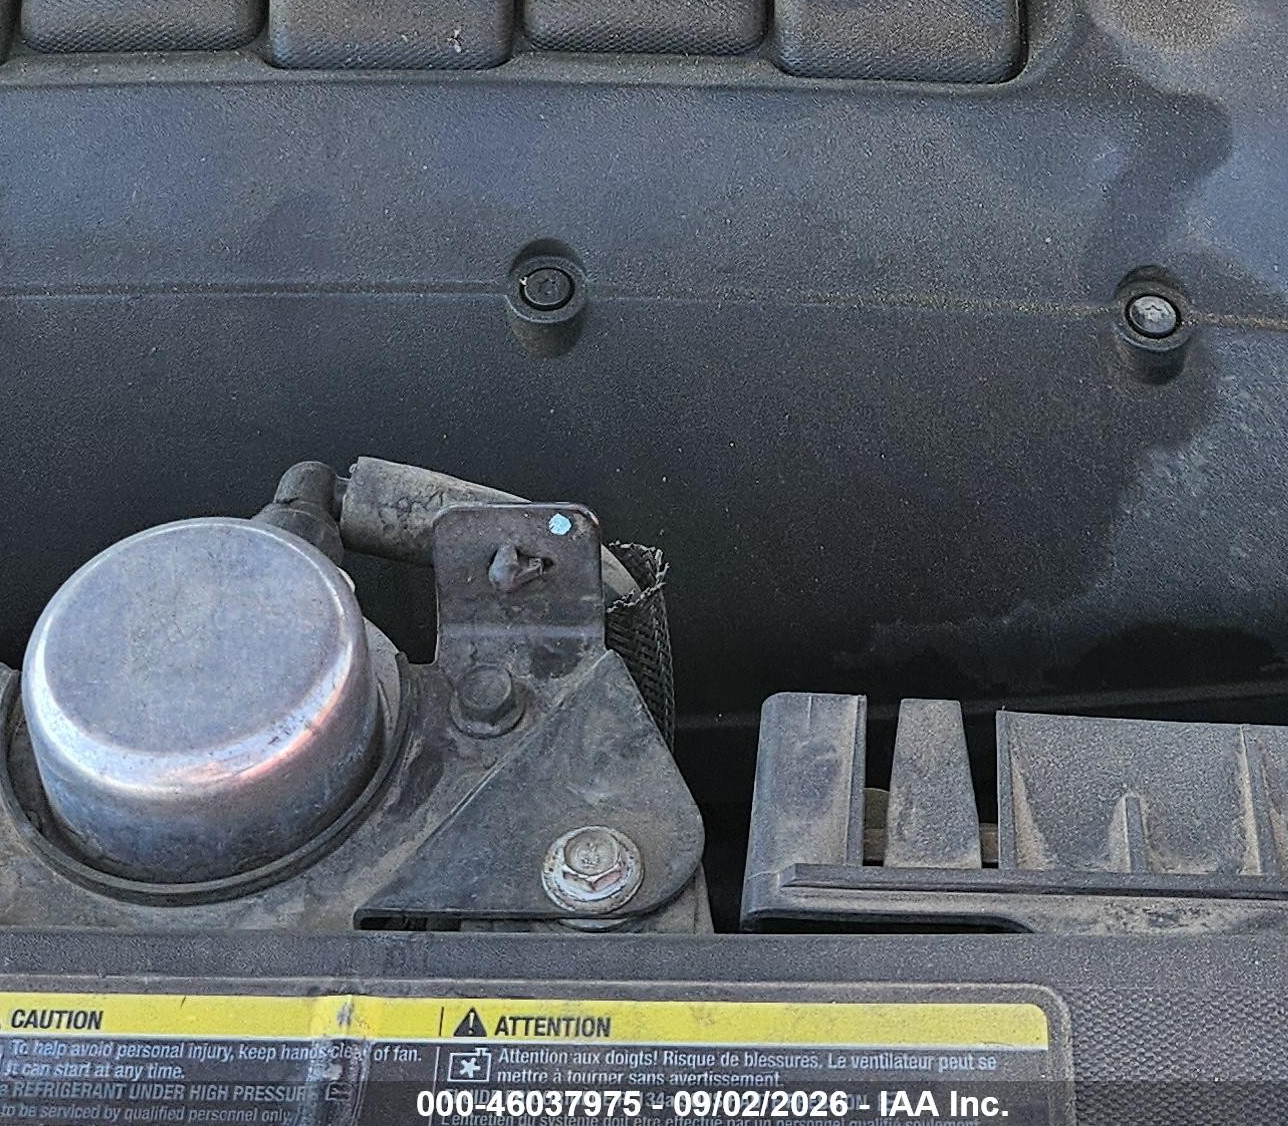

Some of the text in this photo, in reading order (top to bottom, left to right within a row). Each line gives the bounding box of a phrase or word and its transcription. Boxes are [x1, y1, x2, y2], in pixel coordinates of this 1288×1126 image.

[11, 1008, 103, 1031] CAUTION
[494, 1015, 611, 1039] ATTENTION
[12, 1039, 29, 1055] To
[33, 1040, 68, 1059] help
[72, 1041, 114, 1057] avoid
[116, 1041, 183, 1061] personal
[188, 1043, 234, 1063] injury,
[239, 1042, 276, 1062] keep
[281, 1043, 328, 1061] hands
[374, 1045, 391, 1062] of
[393, 1045, 422, 1062] fan.
[498, 1047, 998, 1073] Attention aux doigts! Risque de blessures. Le ventilateur peut se
[21, 1062, 50, 1076] can
[54, 1061, 92, 1077] start
[94, 1061, 112, 1078] at
[114, 1063, 144, 1082] any
[147, 1062, 185, 1079] time.
[497, 1070, 548, 1083] mettre
[567, 1070, 623, 1085] tourner
[629, 1073, 665, 1085] sans
[669, 1071, 785, 1087] avertissement.
[13, 1080, 127, 1100] REFRIGERANT
[130, 1083, 186, 1100] UNDER
[190, 1084, 228, 1101] HIGH
[0, 1102, 16, 1116] to
[19, 1102, 36, 1117] be
[40, 1103, 100, 1120] serviced
[104, 1103, 121, 1122] by
[124, 1104, 185, 1122] qualified
[188, 1106, 258, 1123] personnel
